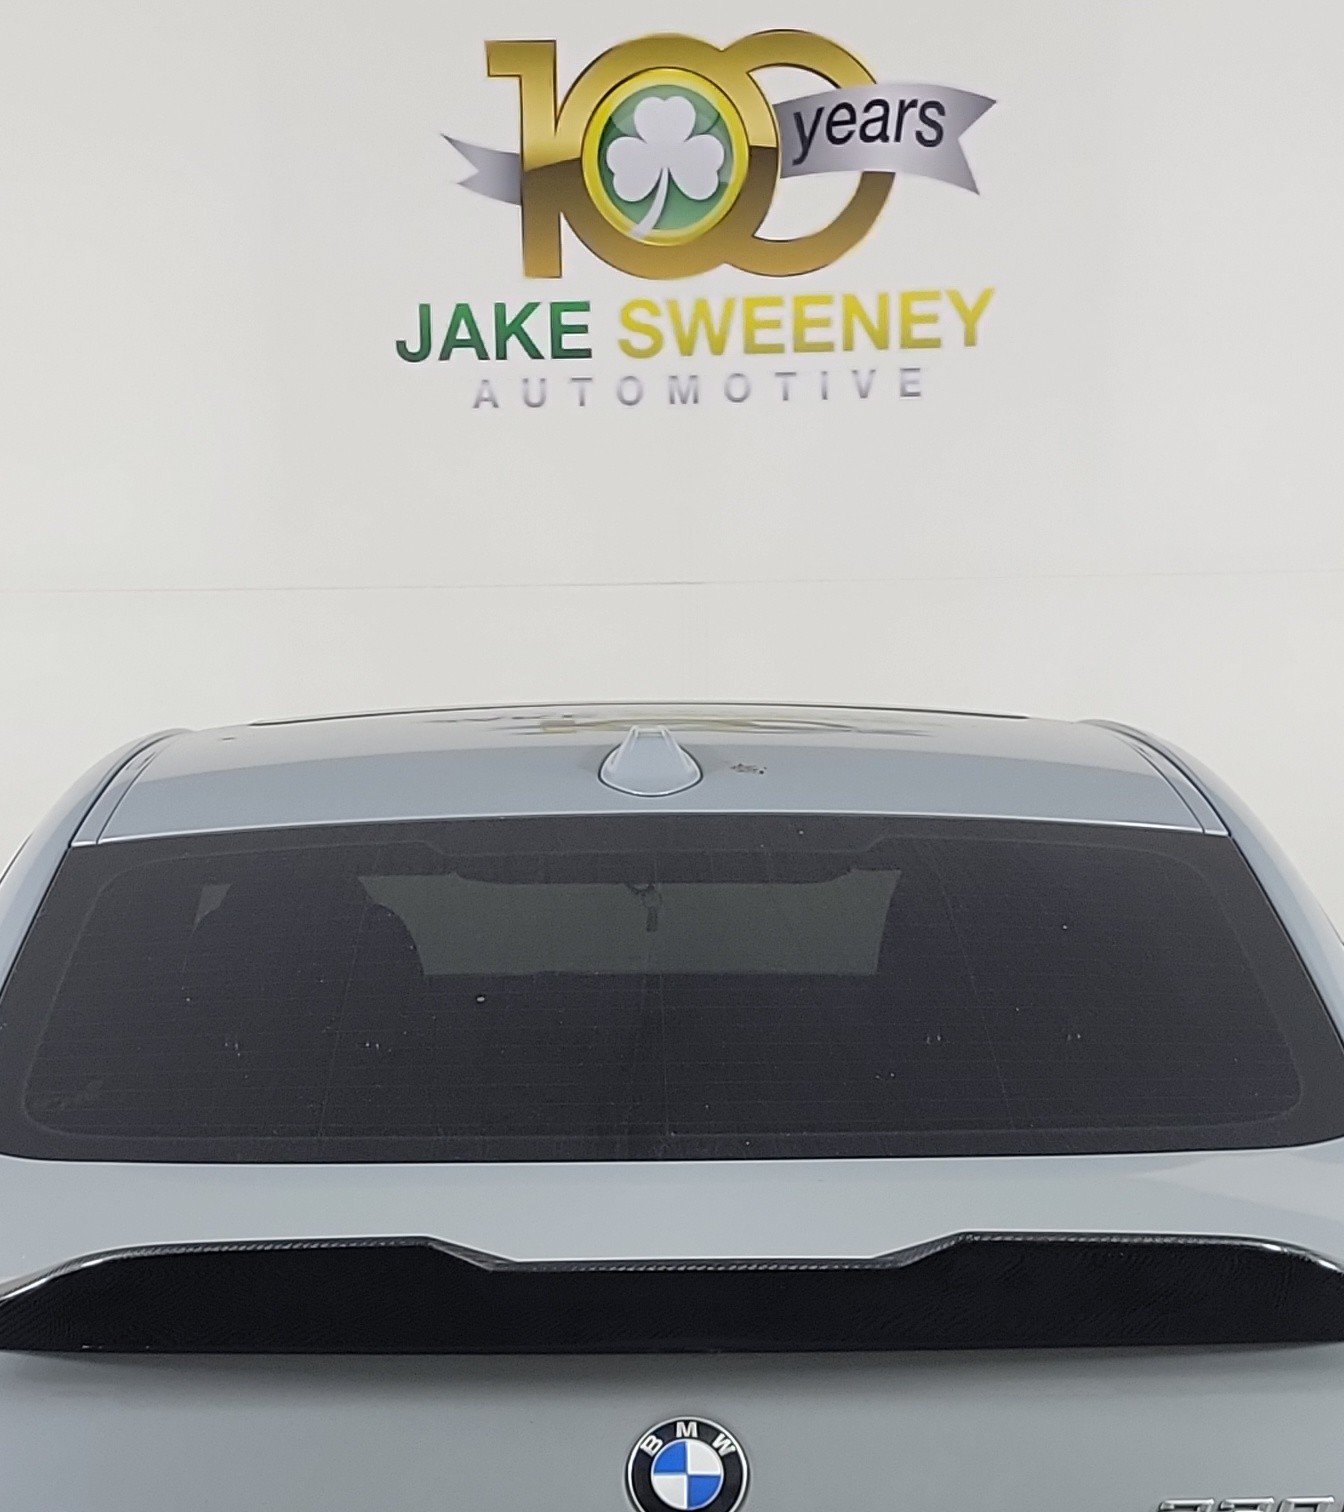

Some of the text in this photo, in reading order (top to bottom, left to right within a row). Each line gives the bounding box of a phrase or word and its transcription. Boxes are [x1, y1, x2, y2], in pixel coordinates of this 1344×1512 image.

[483, 28, 946, 281] 100 years
[395, 288, 996, 364] JAKE SWEENEY
[472, 367, 923, 409] AUTOMOTIVE
[639, 1421, 736, 1457] BMW
